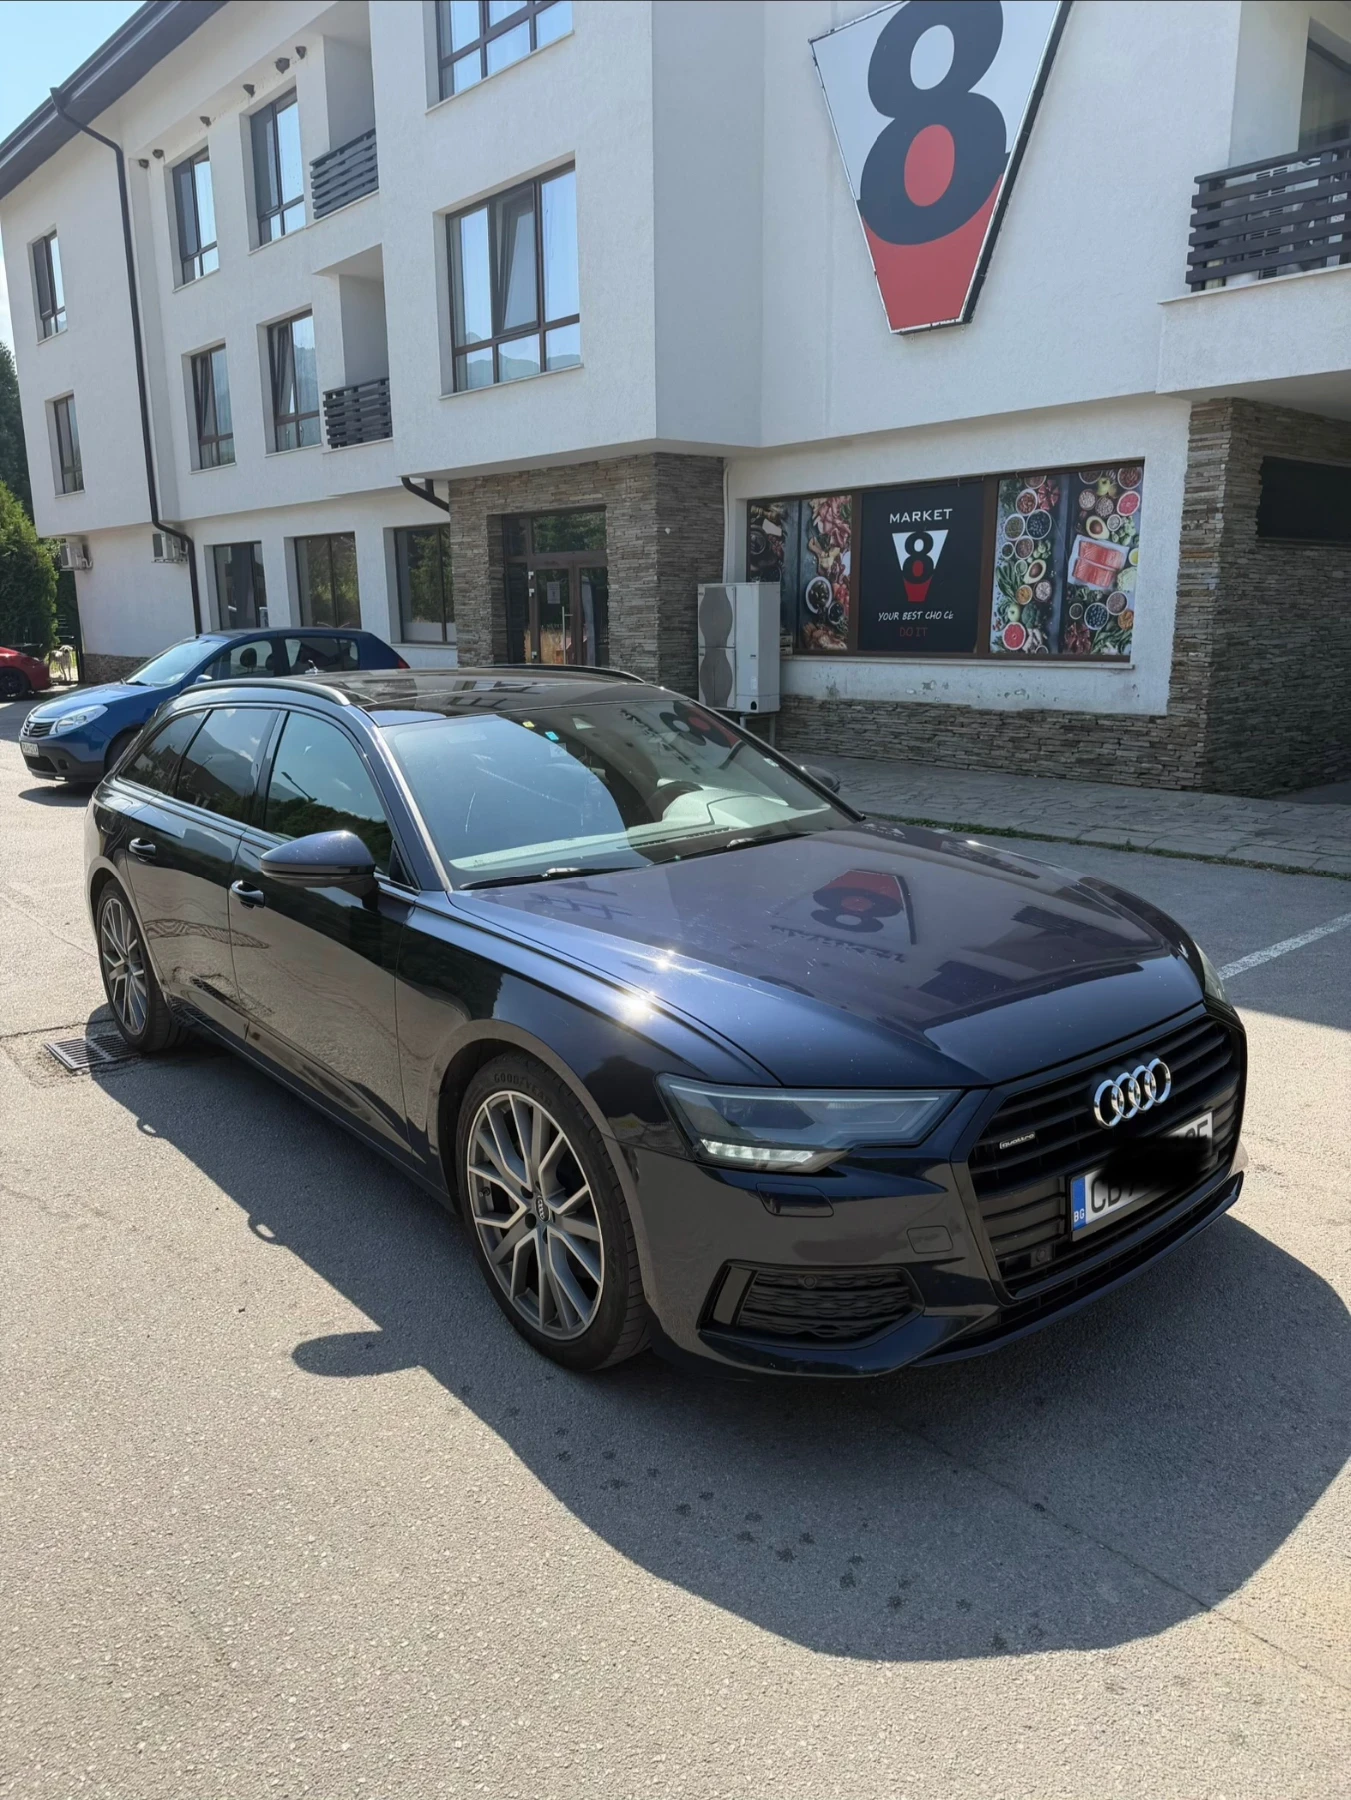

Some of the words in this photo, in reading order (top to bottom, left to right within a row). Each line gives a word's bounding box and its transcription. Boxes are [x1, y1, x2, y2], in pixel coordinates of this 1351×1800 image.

[860, 0, 1007, 246] 8
[889, 508, 953, 524] MARKET
[902, 531, 934, 585] 8
[878, 611, 900, 622] YOUR
[902, 610, 923, 621] BEST
[899, 626, 914, 637] DO
[1073, 1208, 1085, 1223] BG
